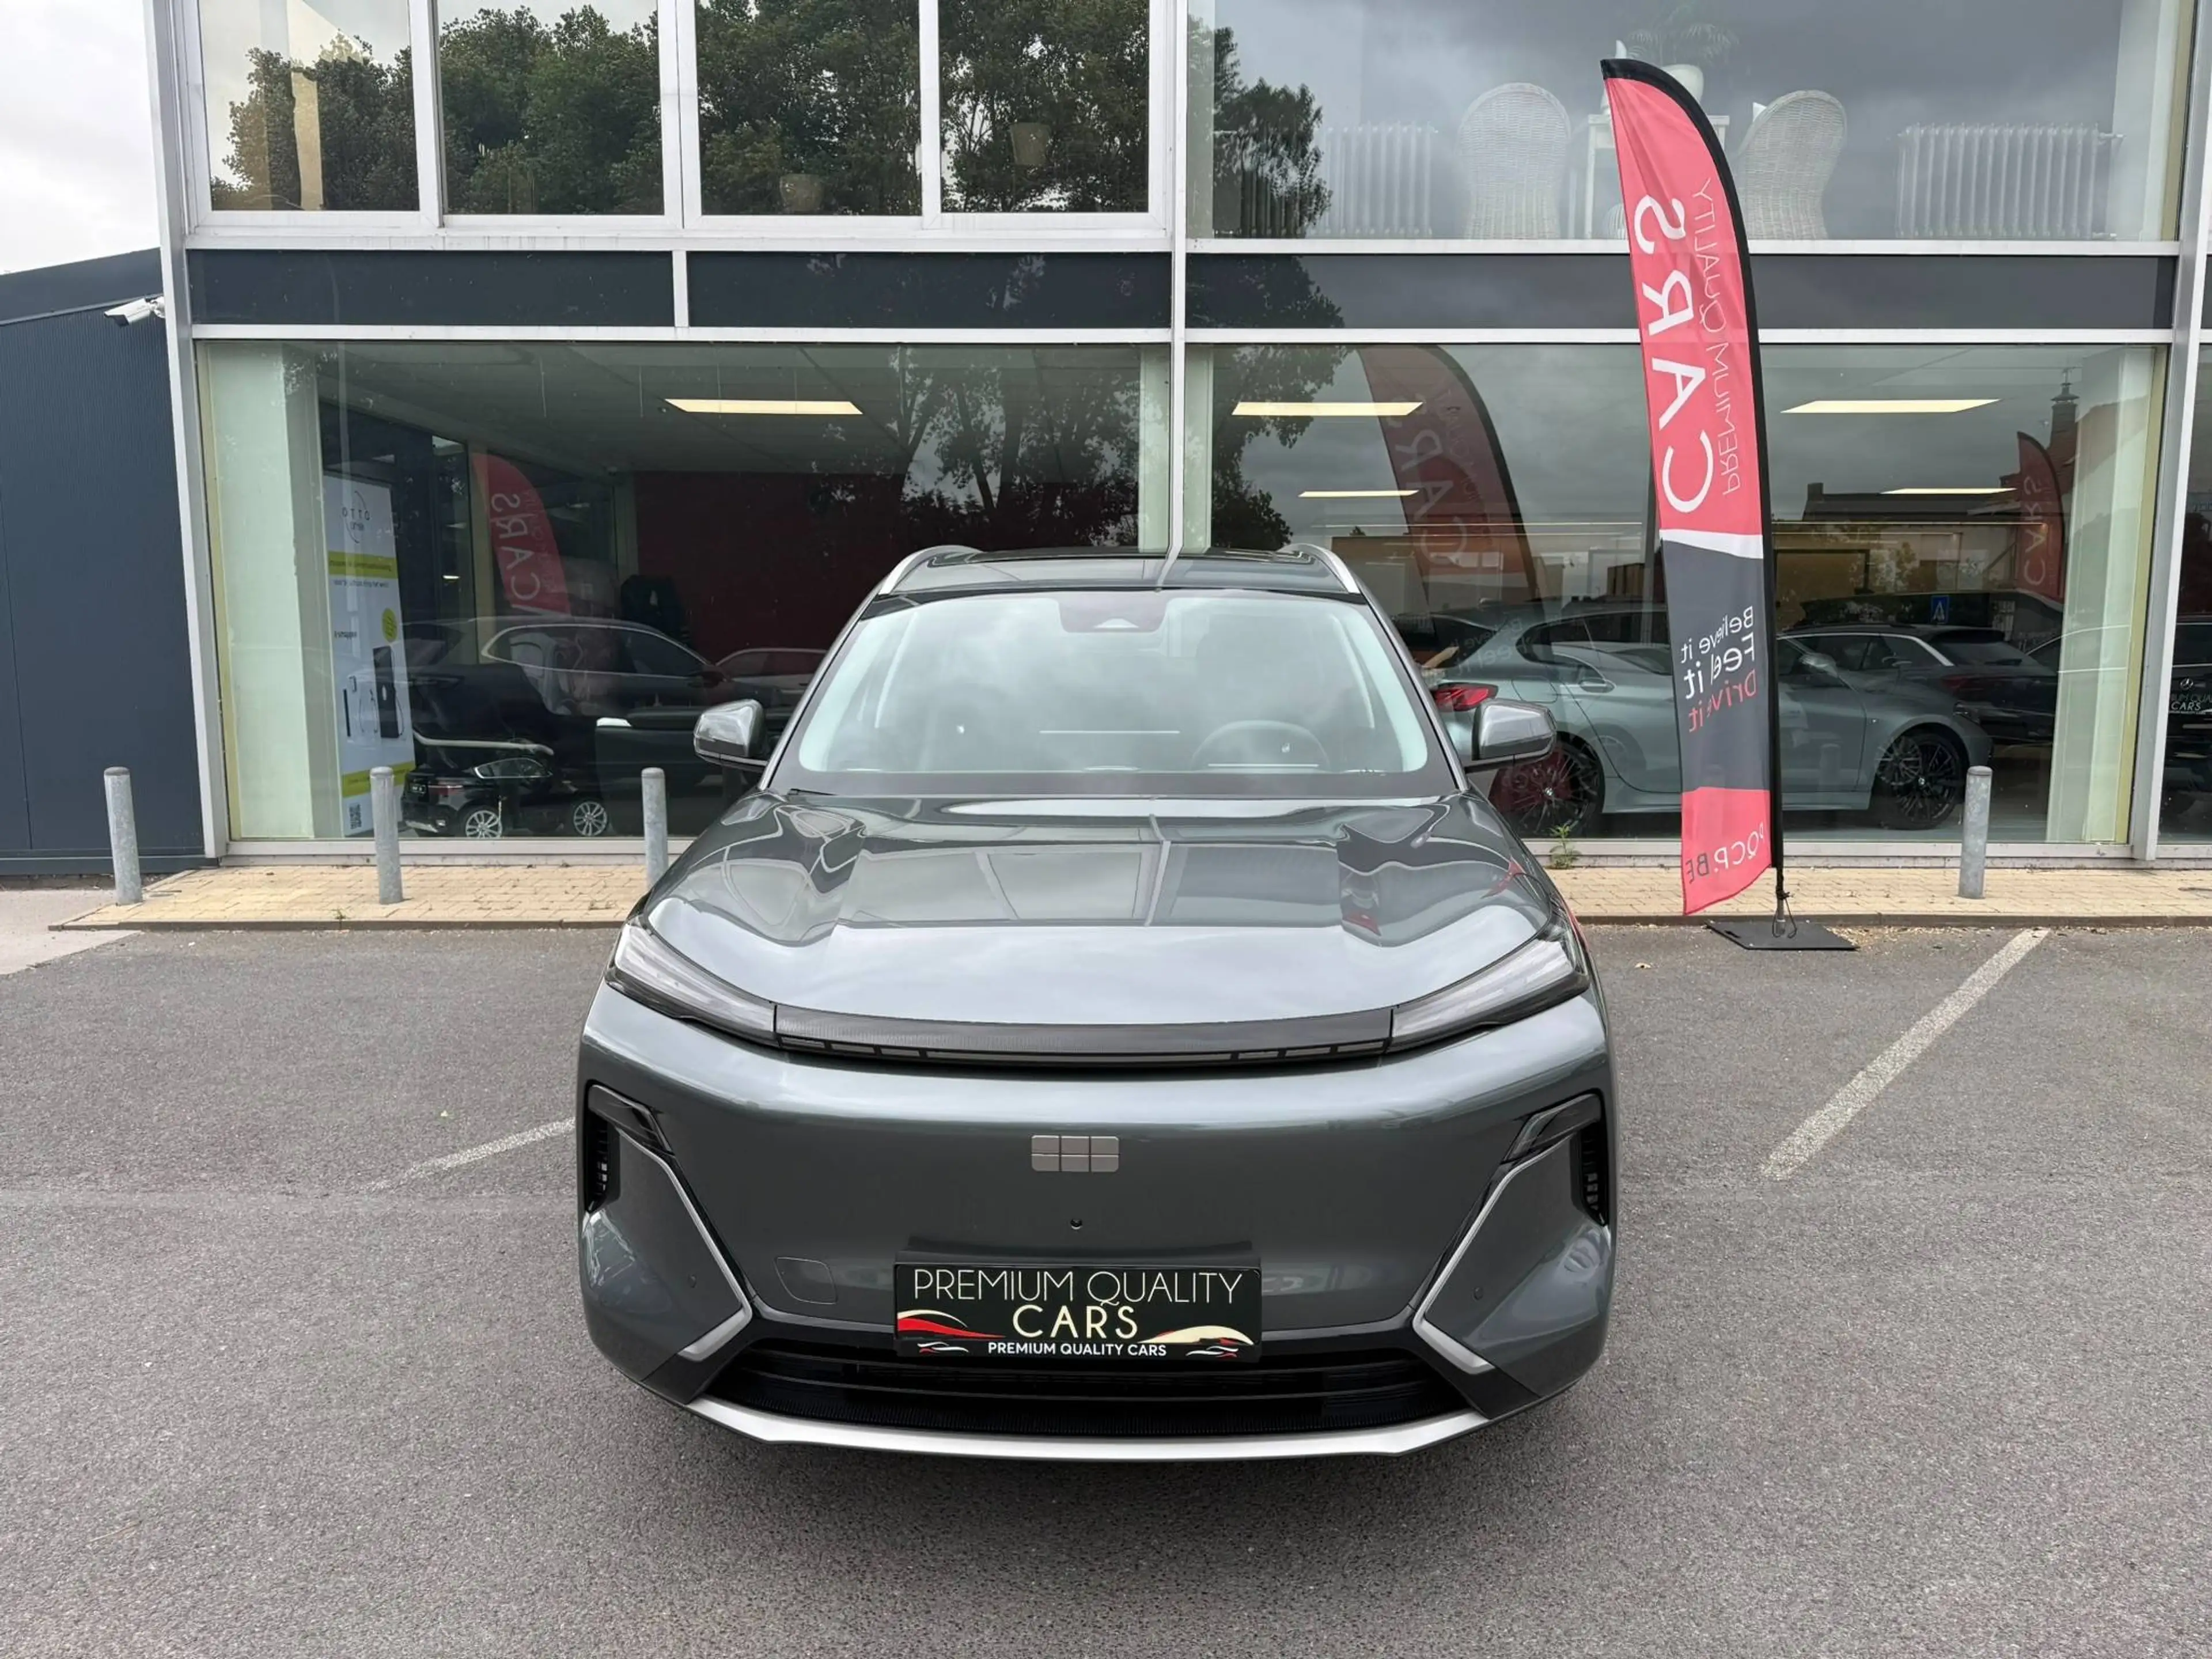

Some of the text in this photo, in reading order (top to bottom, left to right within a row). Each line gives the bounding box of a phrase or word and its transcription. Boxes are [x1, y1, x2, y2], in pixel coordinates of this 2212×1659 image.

[914, 1269, 1243, 1306] PREMIUM QUALITY
[1012, 1304, 1138, 1340] CARS
[988, 1341, 1167, 1357] PREMIUM QUALITY CARS
